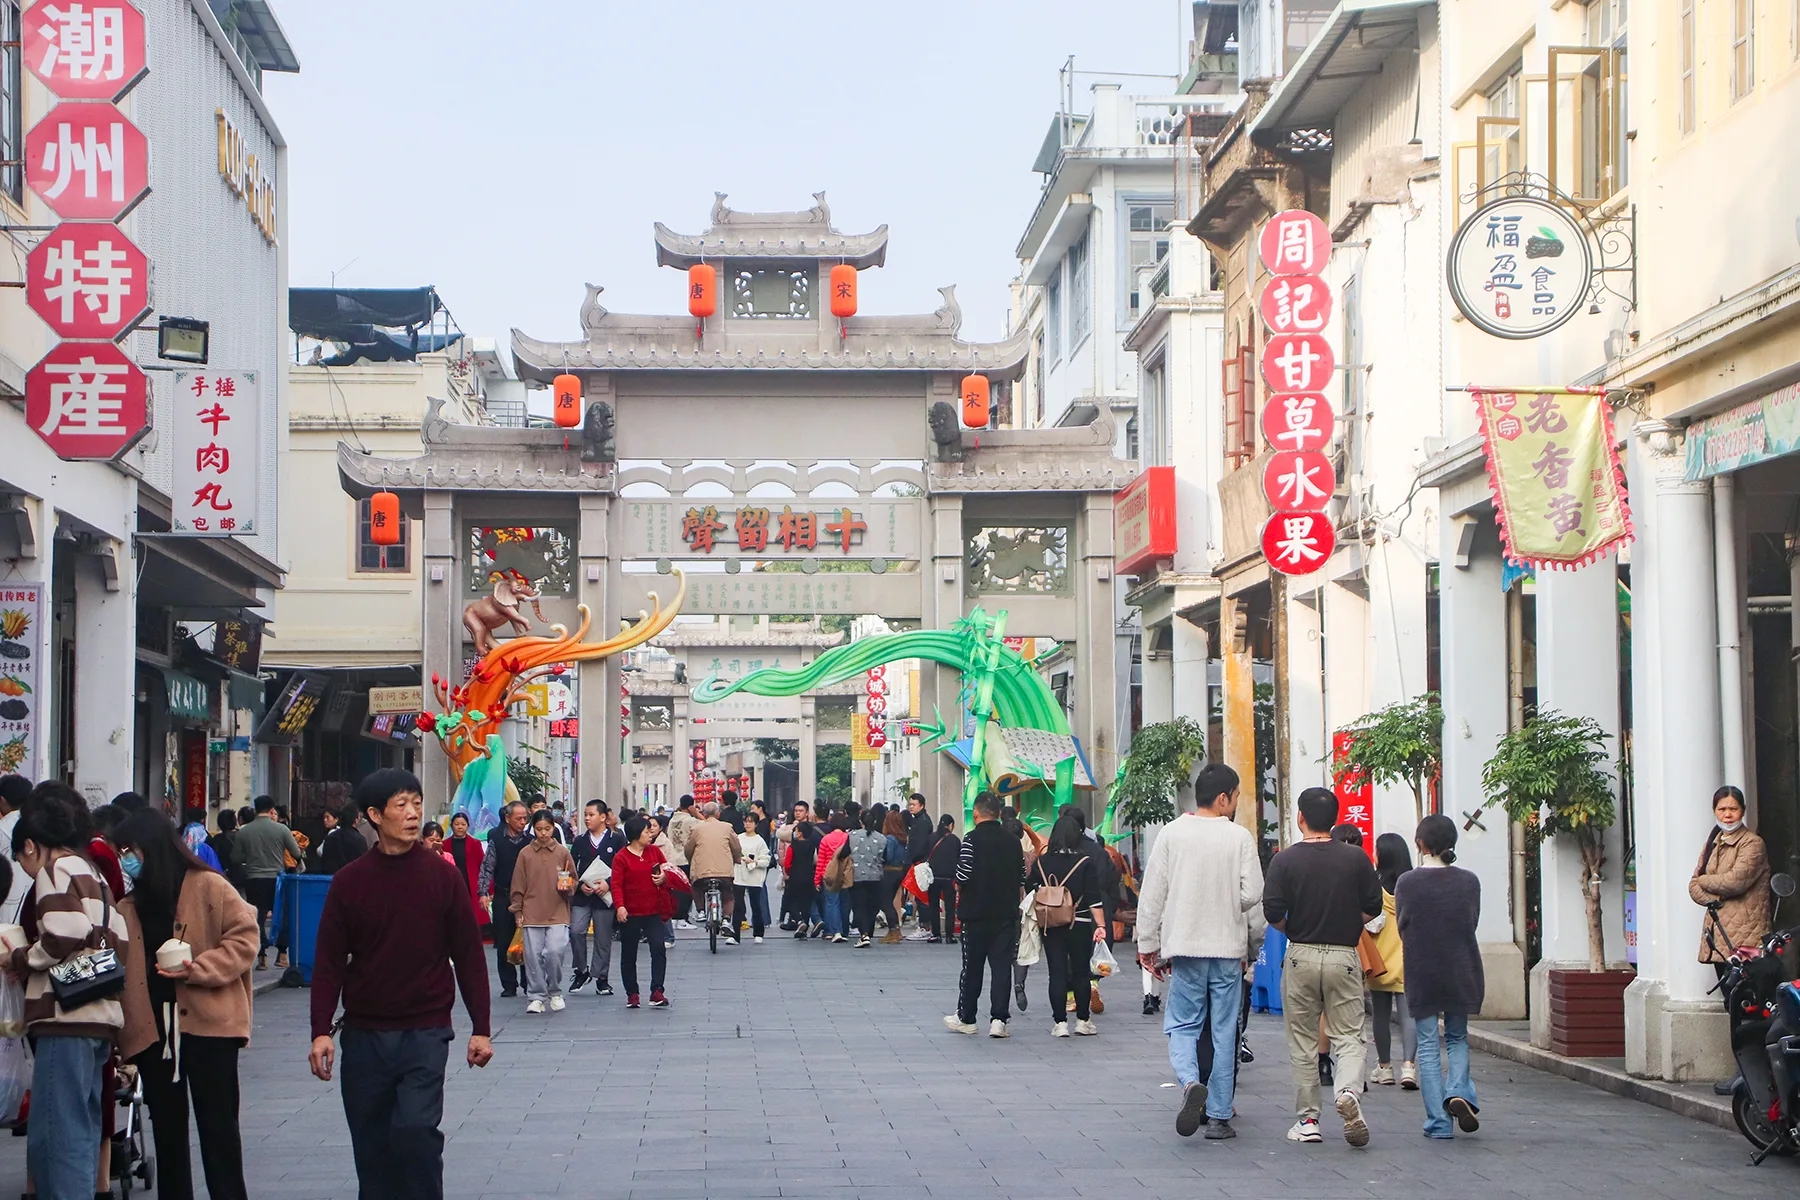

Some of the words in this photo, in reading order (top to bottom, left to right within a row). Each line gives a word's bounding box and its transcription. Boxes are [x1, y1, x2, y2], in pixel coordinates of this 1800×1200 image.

[1486, 215, 1523, 290] 福盈
[688, 283, 704, 300] 唐
[836, 282, 852, 300] 宋
[1531, 265, 1557, 316] 食品
[191, 376, 236, 397] 手捶
[1275, 219, 1323, 563] 周記甘草水果
[557, 391, 574, 410] 唐
[966, 390, 982, 409] 宋
[1494, 393, 1520, 436] 正宗
[192, 402, 233, 511] 牛肉丸
[1524, 393, 1587, 542] 老香黄
[192, 516, 236, 531] 包邮
[373, 510, 386, 528] 唐
